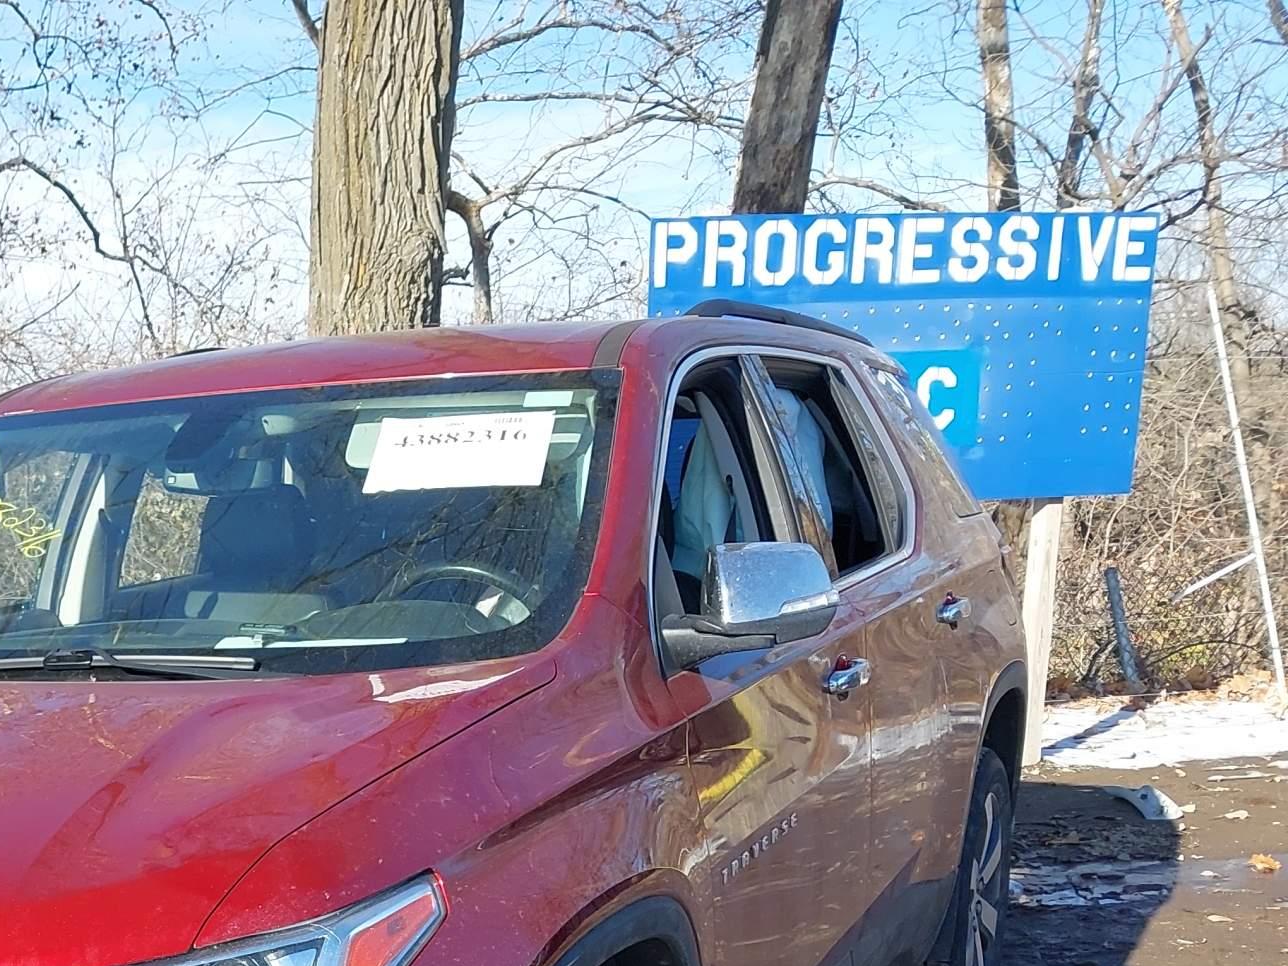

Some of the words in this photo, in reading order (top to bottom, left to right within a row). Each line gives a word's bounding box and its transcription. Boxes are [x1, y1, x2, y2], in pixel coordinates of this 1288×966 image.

[653, 215, 1158, 289] PROGRESSIVE
[393, 428, 528, 448] 43882316
[720, 812, 800, 885] TRAVERSE
